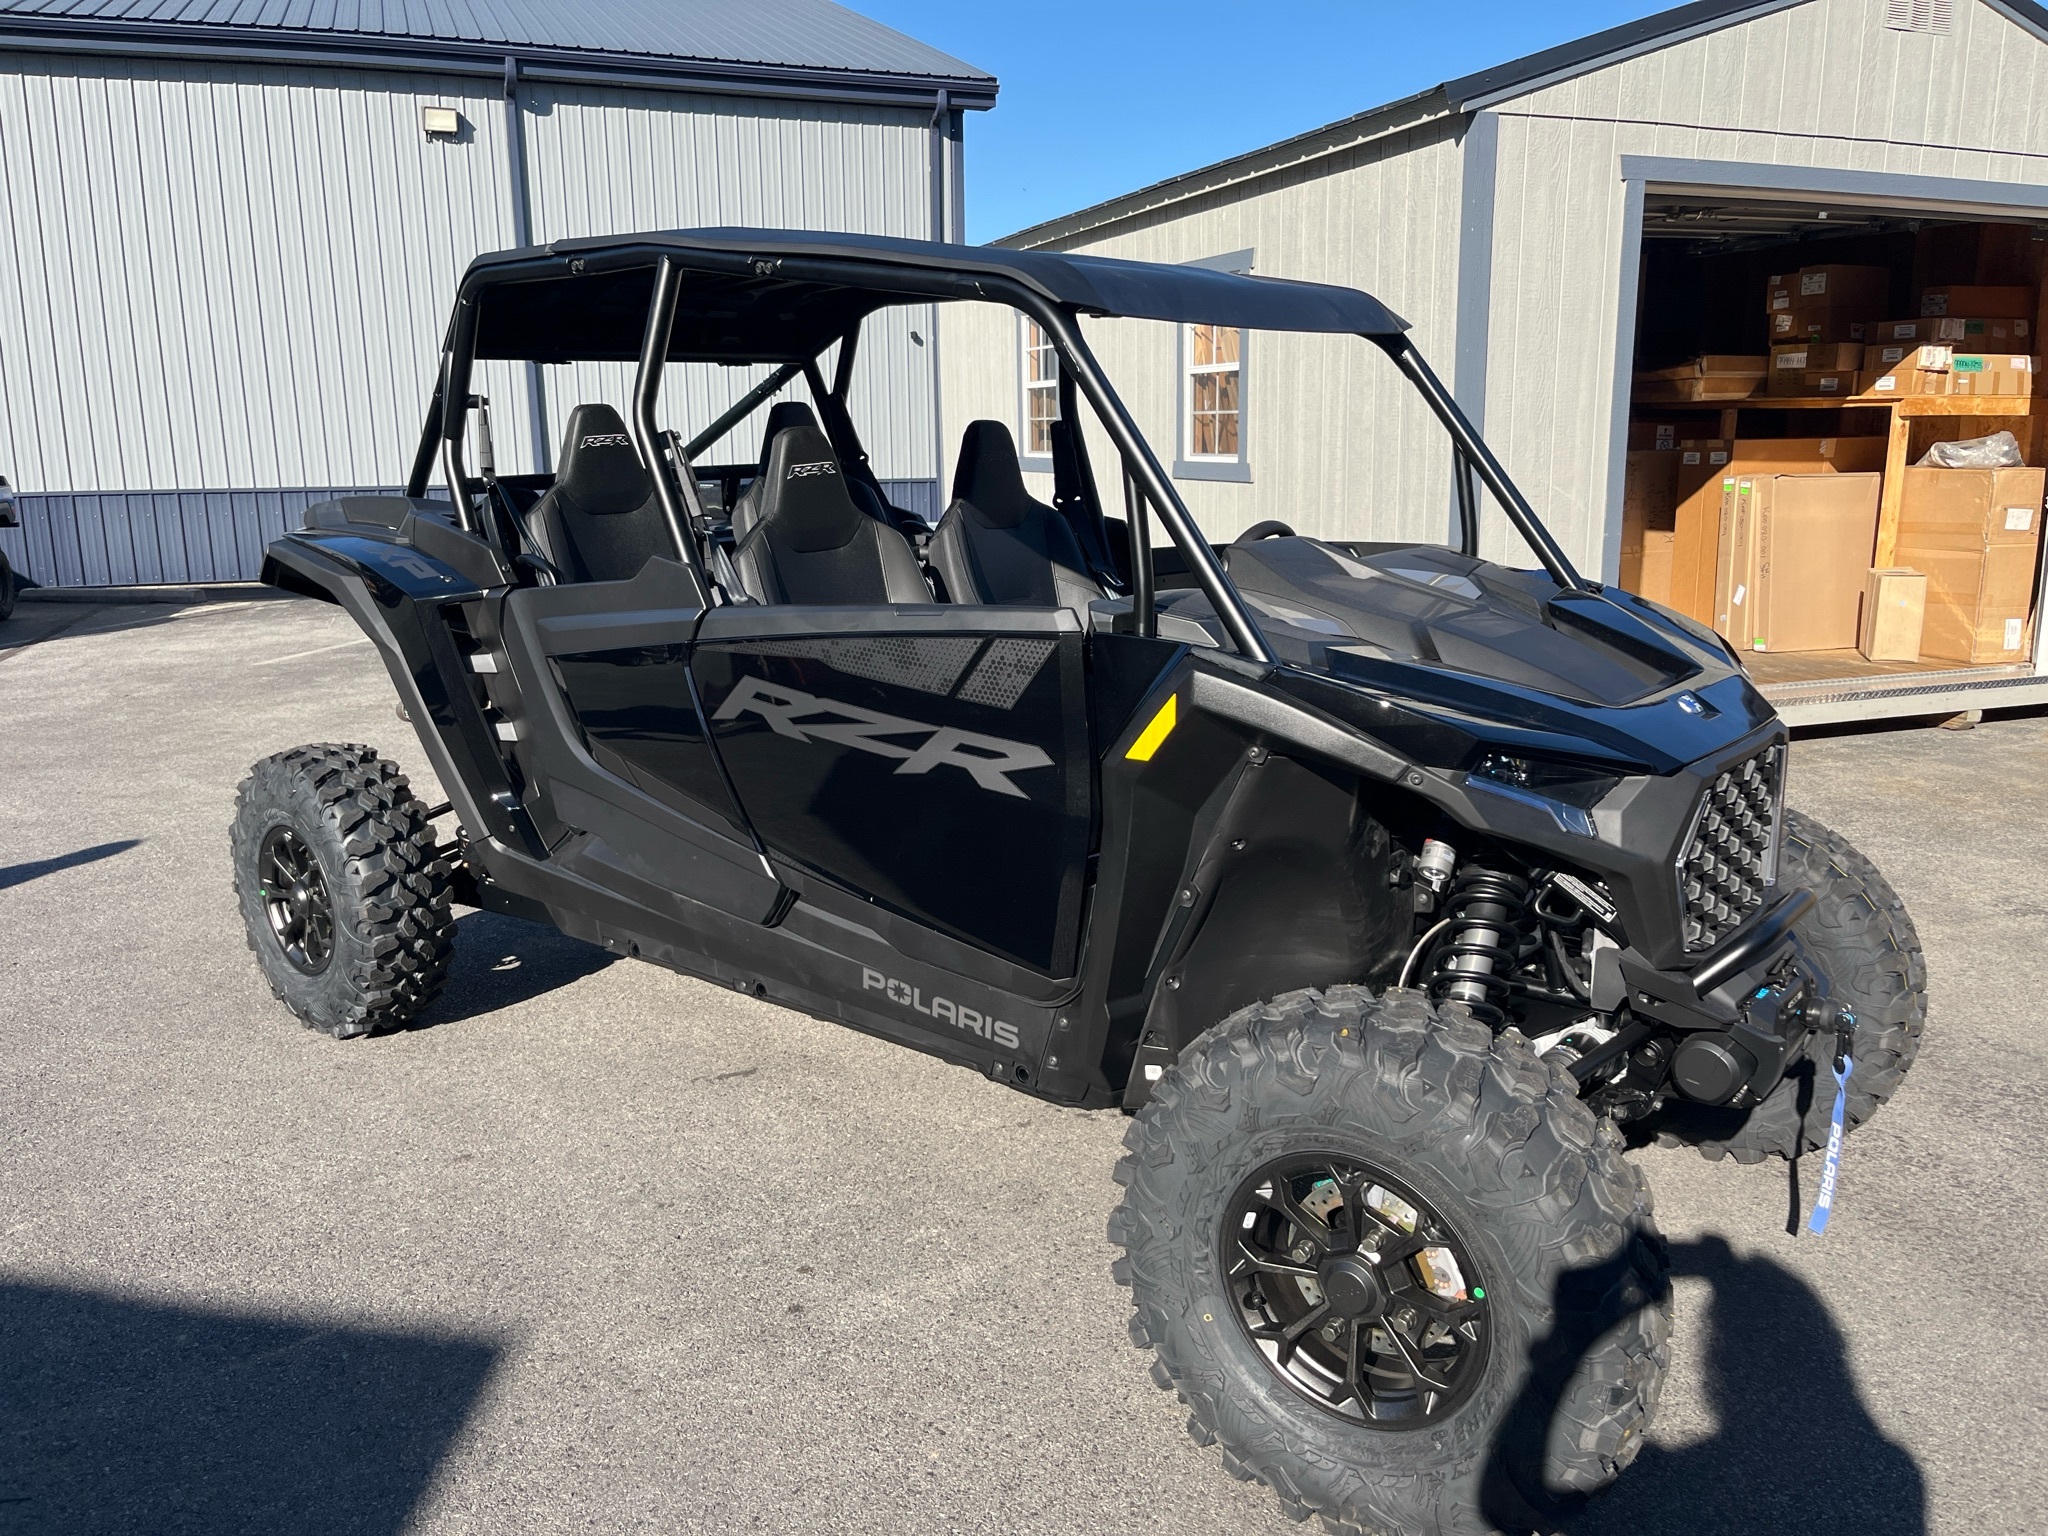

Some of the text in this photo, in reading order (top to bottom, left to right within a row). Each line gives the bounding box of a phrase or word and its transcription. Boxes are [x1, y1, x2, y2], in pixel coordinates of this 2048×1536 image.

[580, 433, 629, 449] RZR
[787, 460, 836, 480] RZR
[711, 674, 1055, 800] RZR
[862, 967, 1019, 1049] POLARIS
[1818, 1122, 1842, 1209] POLARIS
